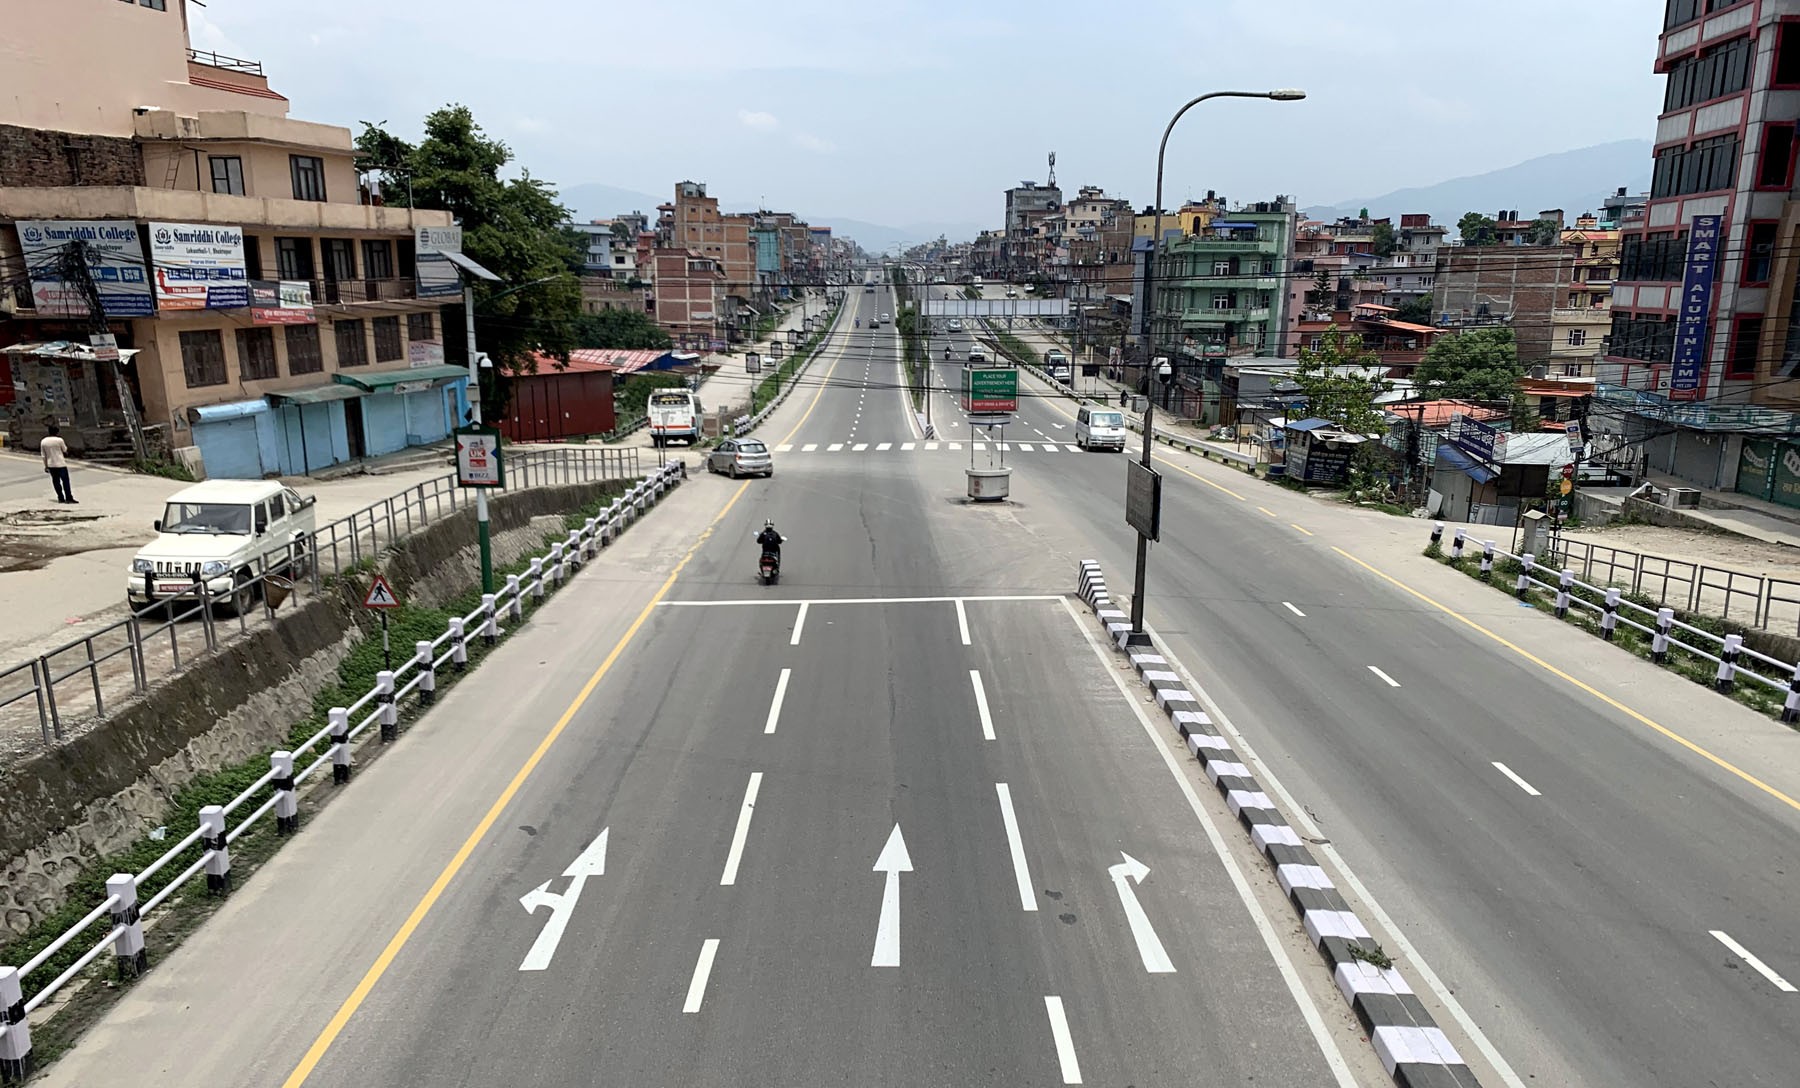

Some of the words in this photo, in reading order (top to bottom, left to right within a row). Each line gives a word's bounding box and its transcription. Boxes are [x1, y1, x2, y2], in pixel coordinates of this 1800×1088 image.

[44, 226, 97, 240] Samriddhi
[99, 227, 136, 241] College
[173, 229, 214, 243] Samriddhi
[215, 231, 241, 247] College
[1692, 218, 1714, 273] SMART
[1678, 284, 1704, 377] ALUMINIUM
